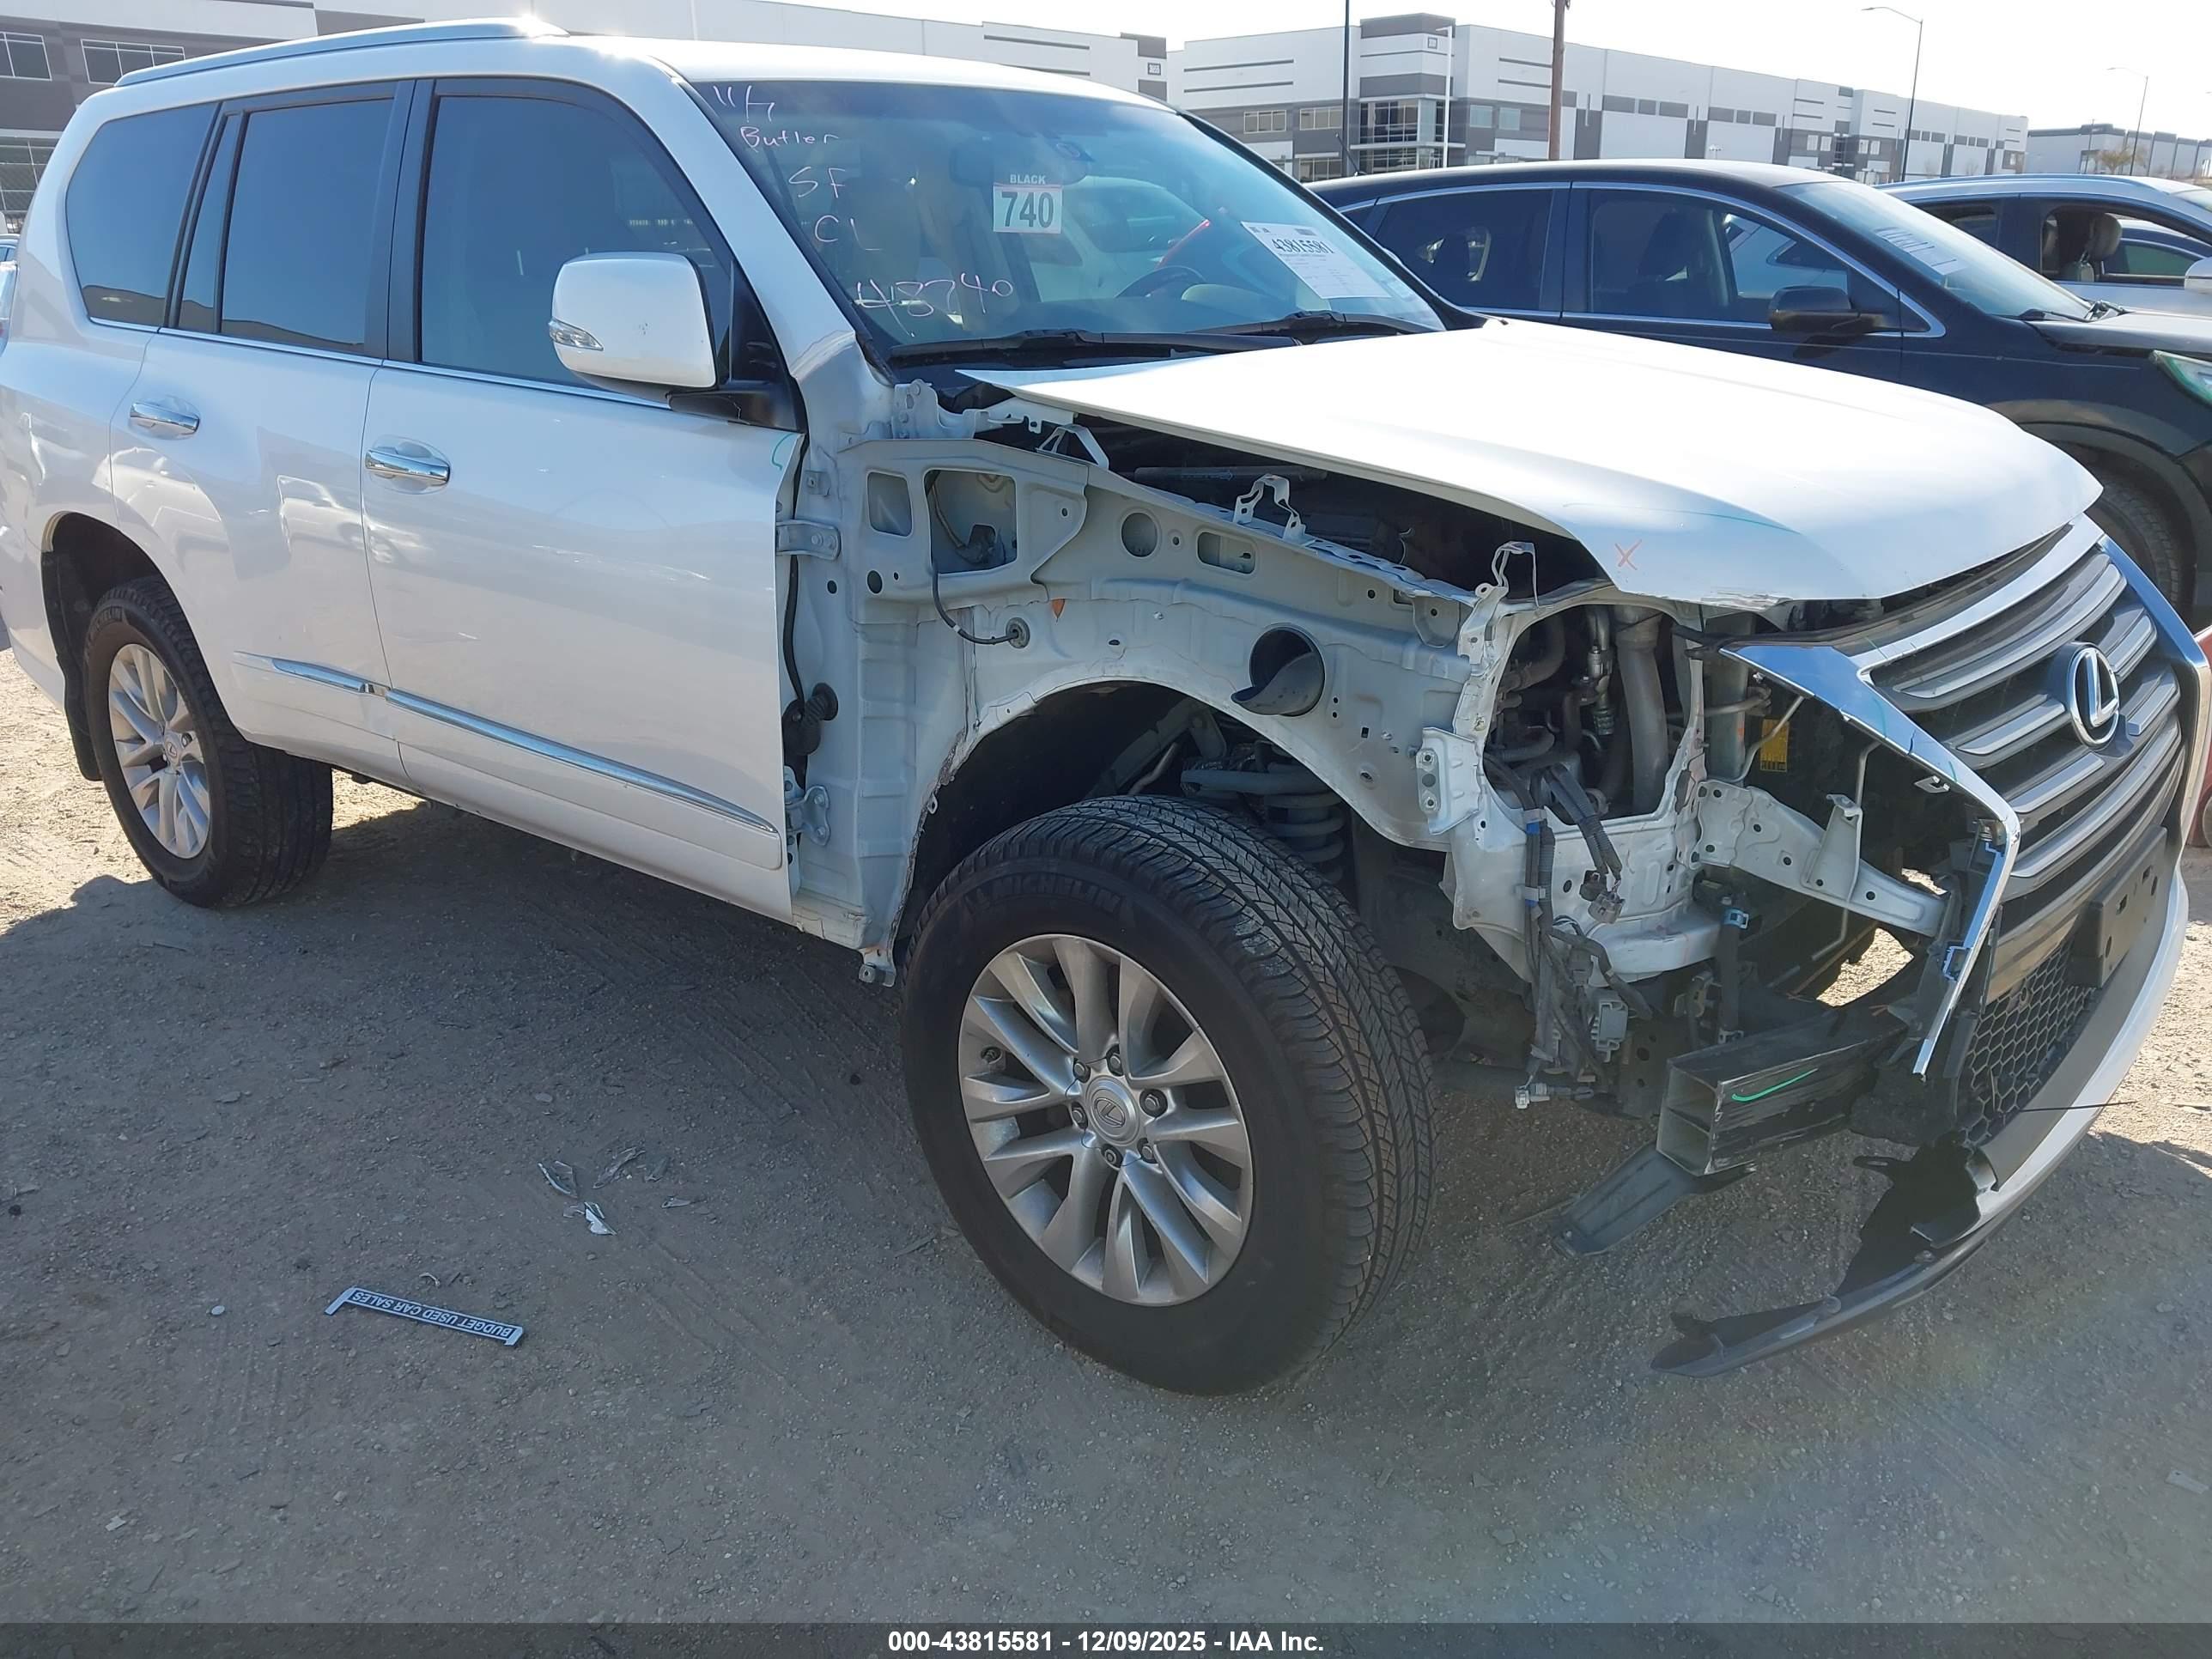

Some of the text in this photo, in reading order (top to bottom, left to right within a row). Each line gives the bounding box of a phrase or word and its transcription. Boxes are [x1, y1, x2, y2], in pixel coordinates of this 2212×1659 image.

[740, 126, 839, 153] Butler
[1010, 174, 1046, 185] BLACK
[1001, 191, 1054, 228] 740
[1271, 238, 1334, 254] 43815581
[992, 872, 1121, 915] MICHELIN
[352, 1291, 514, 1337] BUDGET USED CAR SALES
